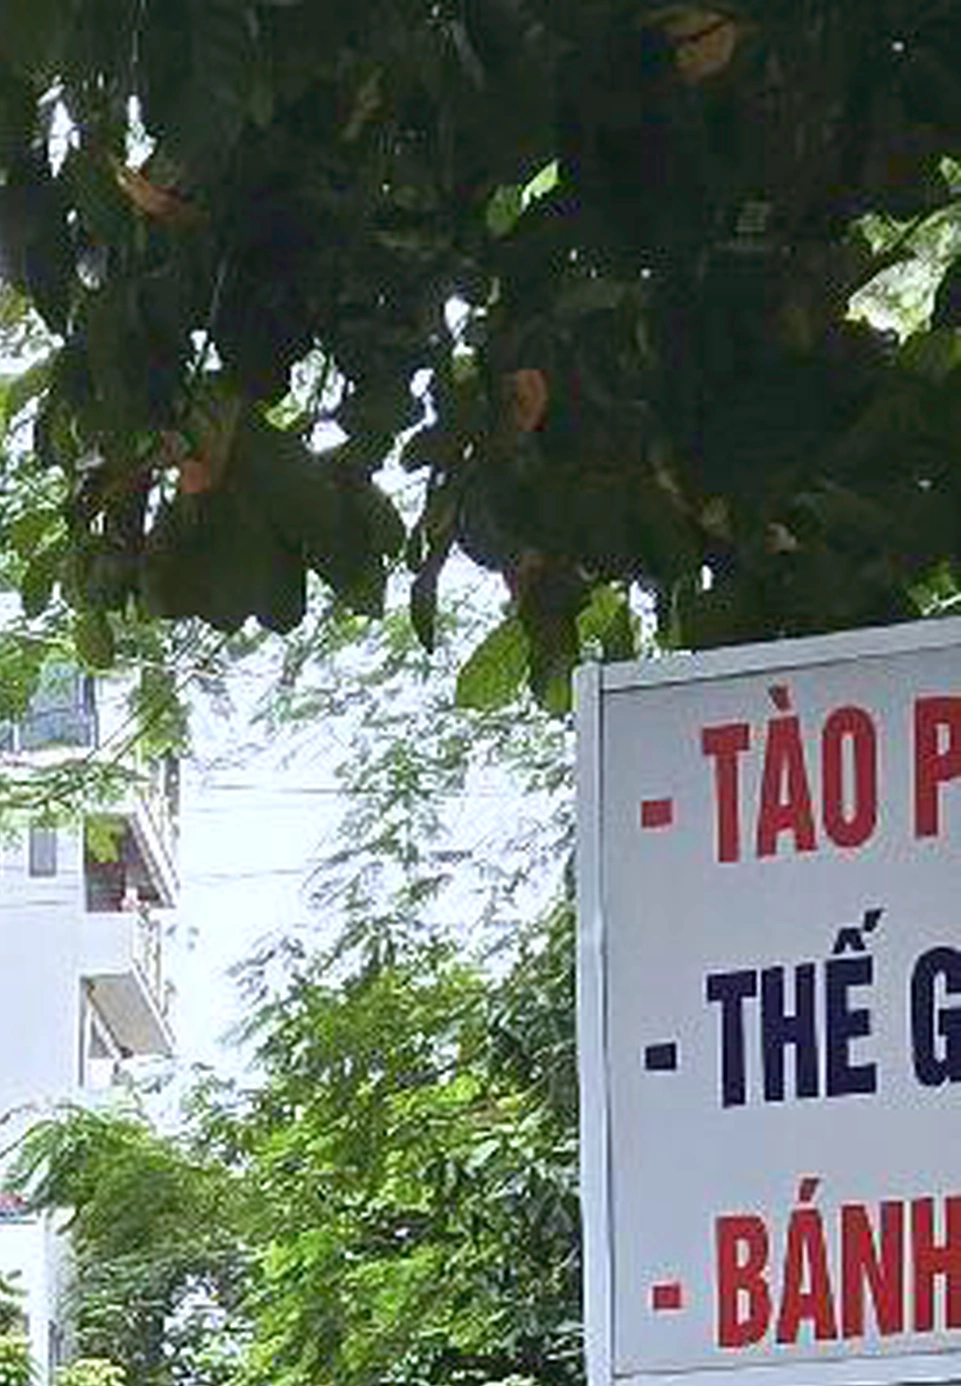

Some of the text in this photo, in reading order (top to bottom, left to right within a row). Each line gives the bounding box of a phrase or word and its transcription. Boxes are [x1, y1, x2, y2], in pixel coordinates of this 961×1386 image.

[700, 684, 879, 864] TÀO
[705, 907, 884, 1108] THẾ
[715, 1178, 961, 1350] BÁNH
